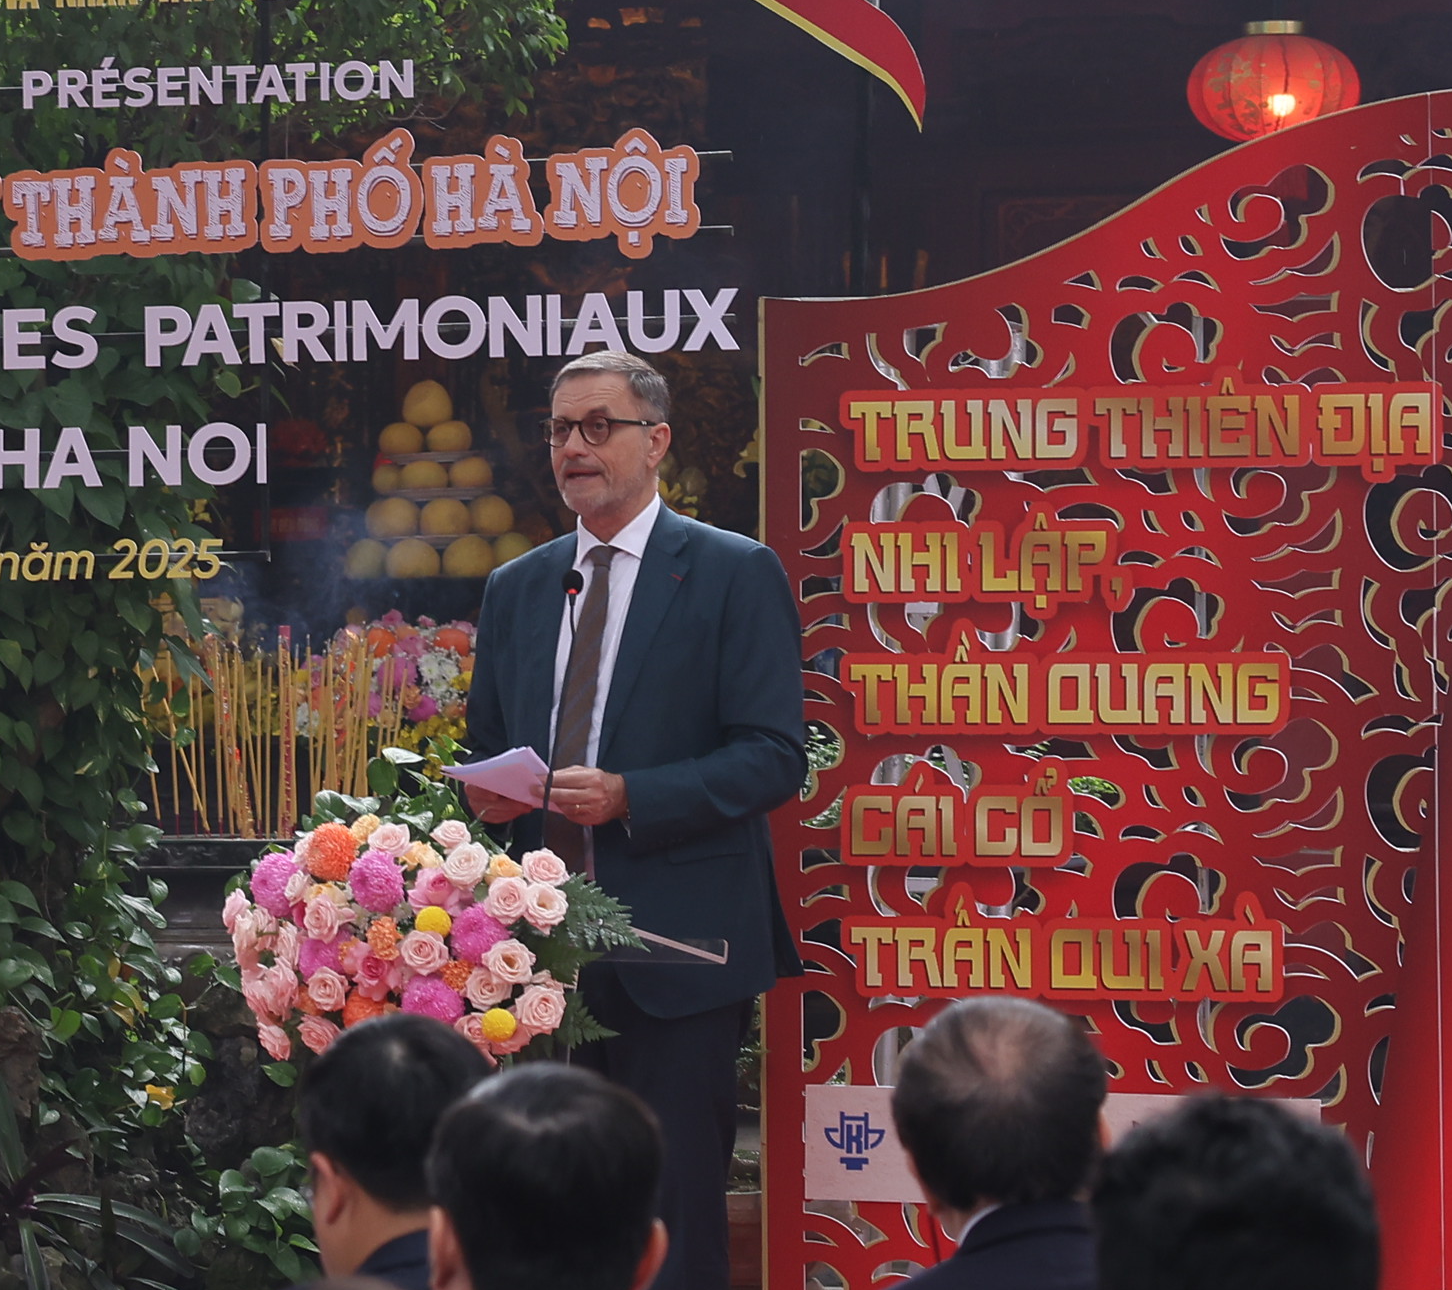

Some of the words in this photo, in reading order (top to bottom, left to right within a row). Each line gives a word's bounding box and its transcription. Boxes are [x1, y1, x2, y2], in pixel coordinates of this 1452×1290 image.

[22, 56, 415, 110] PRÉSENTATION
[12, 155, 247, 249] THÀNH
[267, 136, 412, 241] PHỐ
[429, 142, 534, 238] HÀ
[553, 137, 690, 246] NỘI
[144, 287, 740, 367] PATRIMONIAUX
[128, 421, 267, 487] NOI
[849, 398, 1079, 461] TRUNG
[1094, 377, 1301, 459] THIÊN
[1318, 393, 1433, 472] ĐỊA
[108, 538, 223, 580] 2025
[849, 532, 963, 592] NHI
[979, 512, 1124, 608] LẬP,
[849, 630, 1029, 725] THẦN
[1047, 662, 1281, 725] QUANG
[850, 773, 958, 857] CÁI
[974, 767, 1064, 856] CỔ
[850, 894, 1032, 989] TRẤN
[1050, 928, 1164, 990] QUI
[1181, 905, 1272, 991] XÀ
